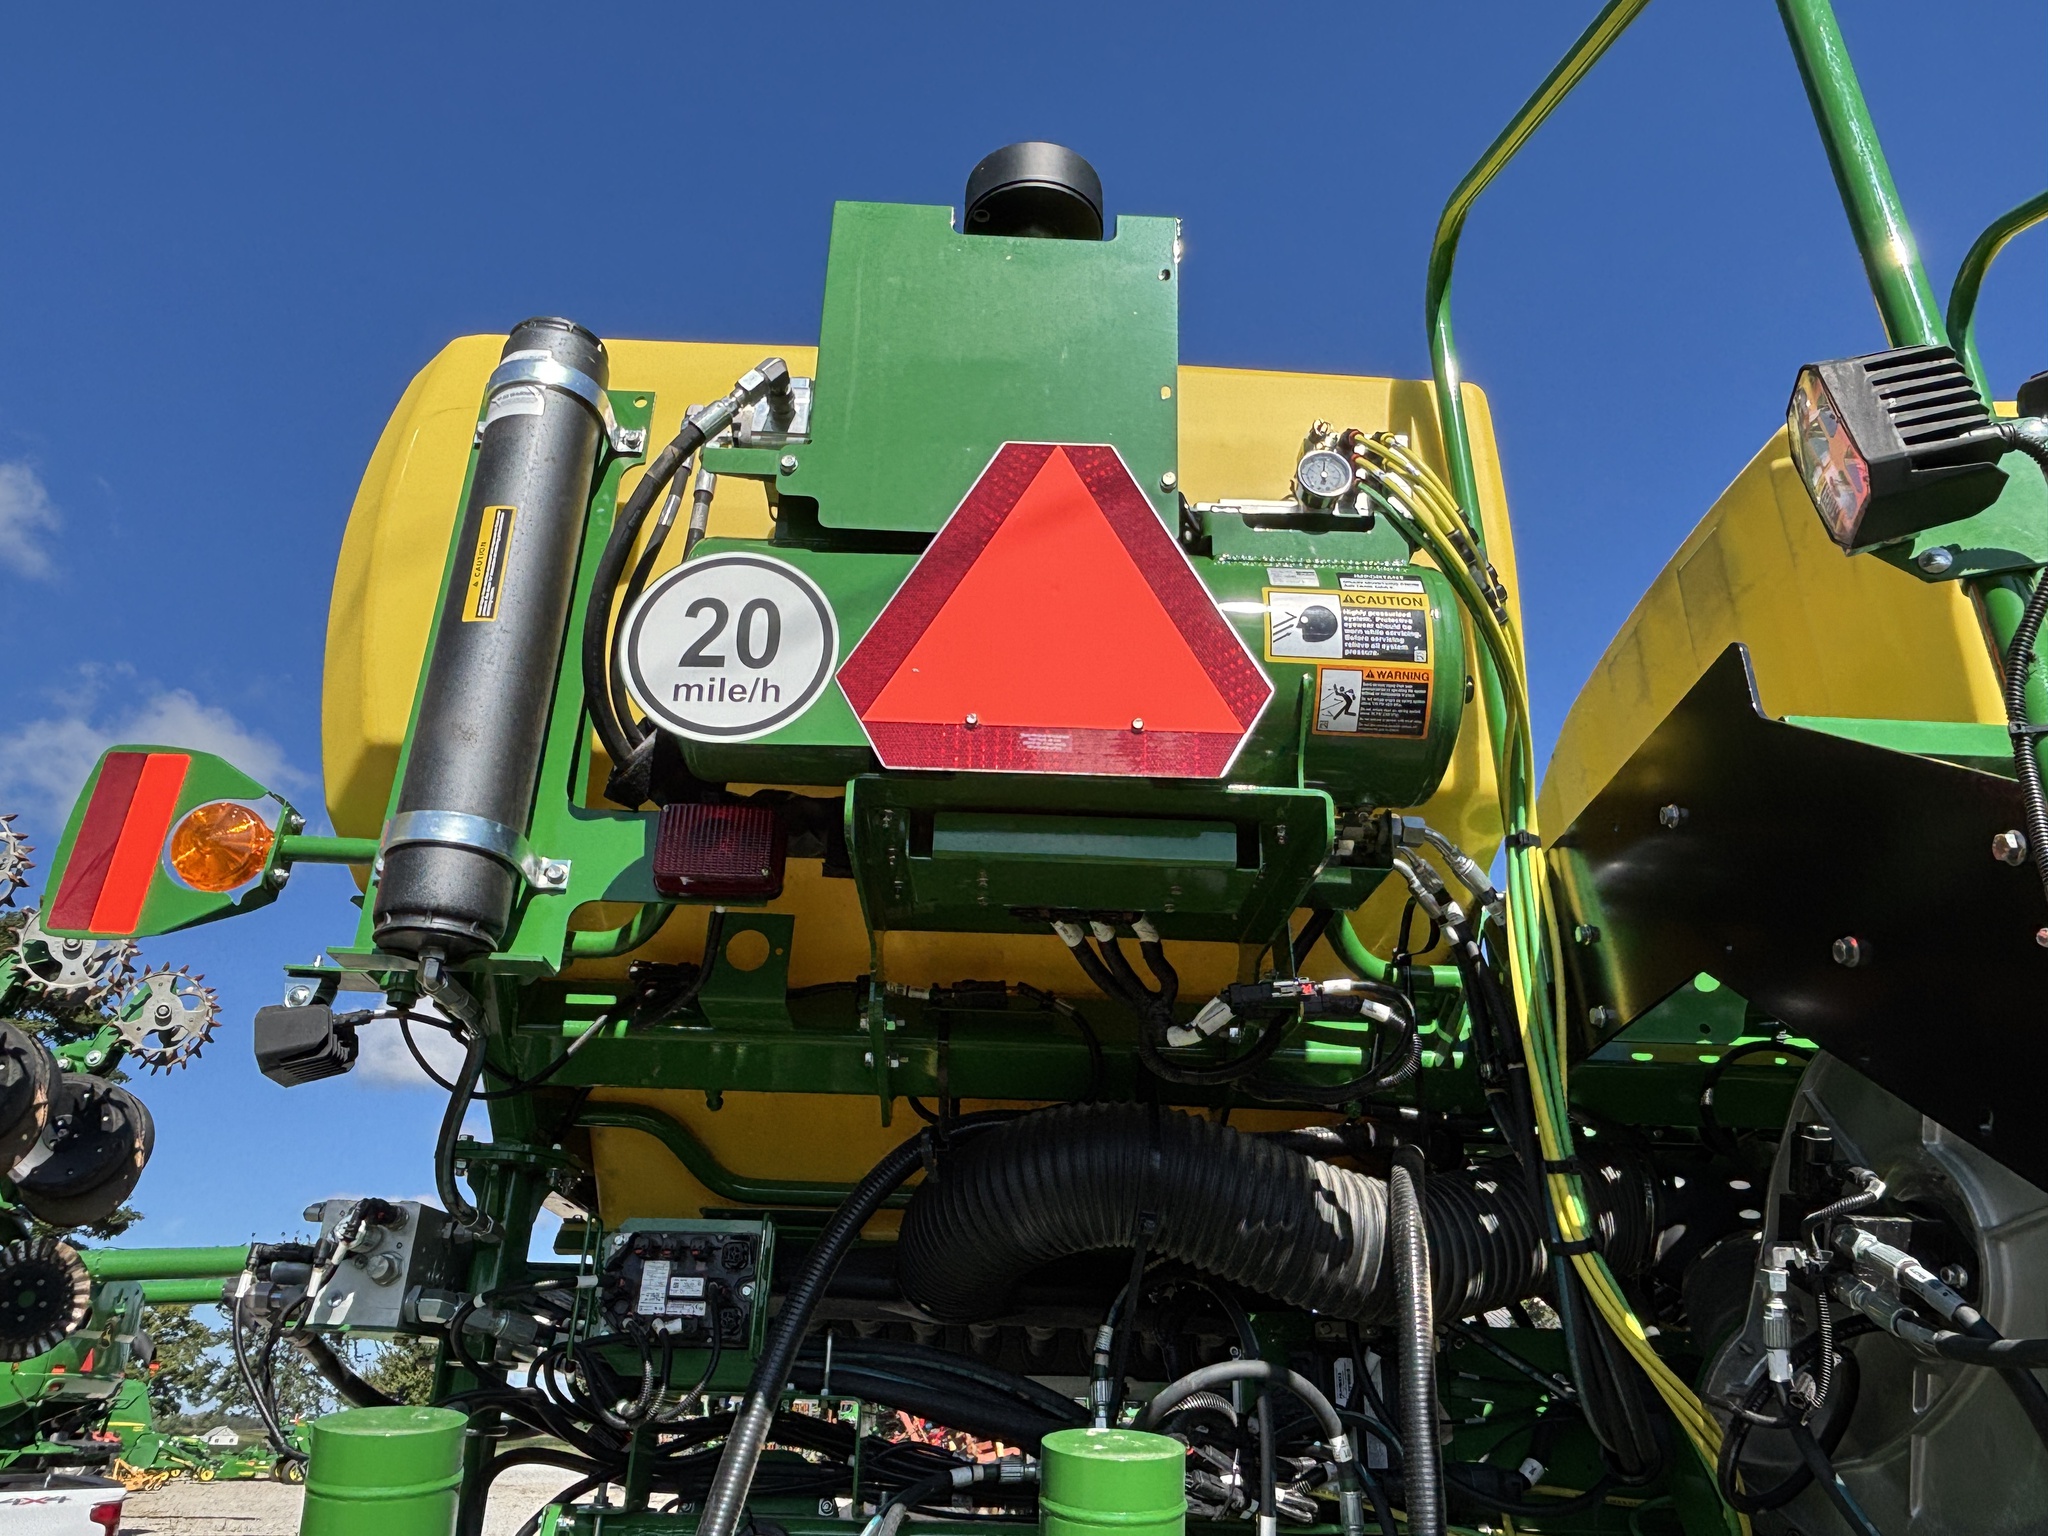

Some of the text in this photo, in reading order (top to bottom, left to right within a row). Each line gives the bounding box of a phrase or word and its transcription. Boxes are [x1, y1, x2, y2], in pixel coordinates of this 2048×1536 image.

[474, 541, 487, 578] CAUTION
[1355, 595, 1423, 607] CAUTION
[677, 597, 781, 669] 20
[1376, 670, 1430, 681] WARNING
[672, 677, 781, 703] mile/h
